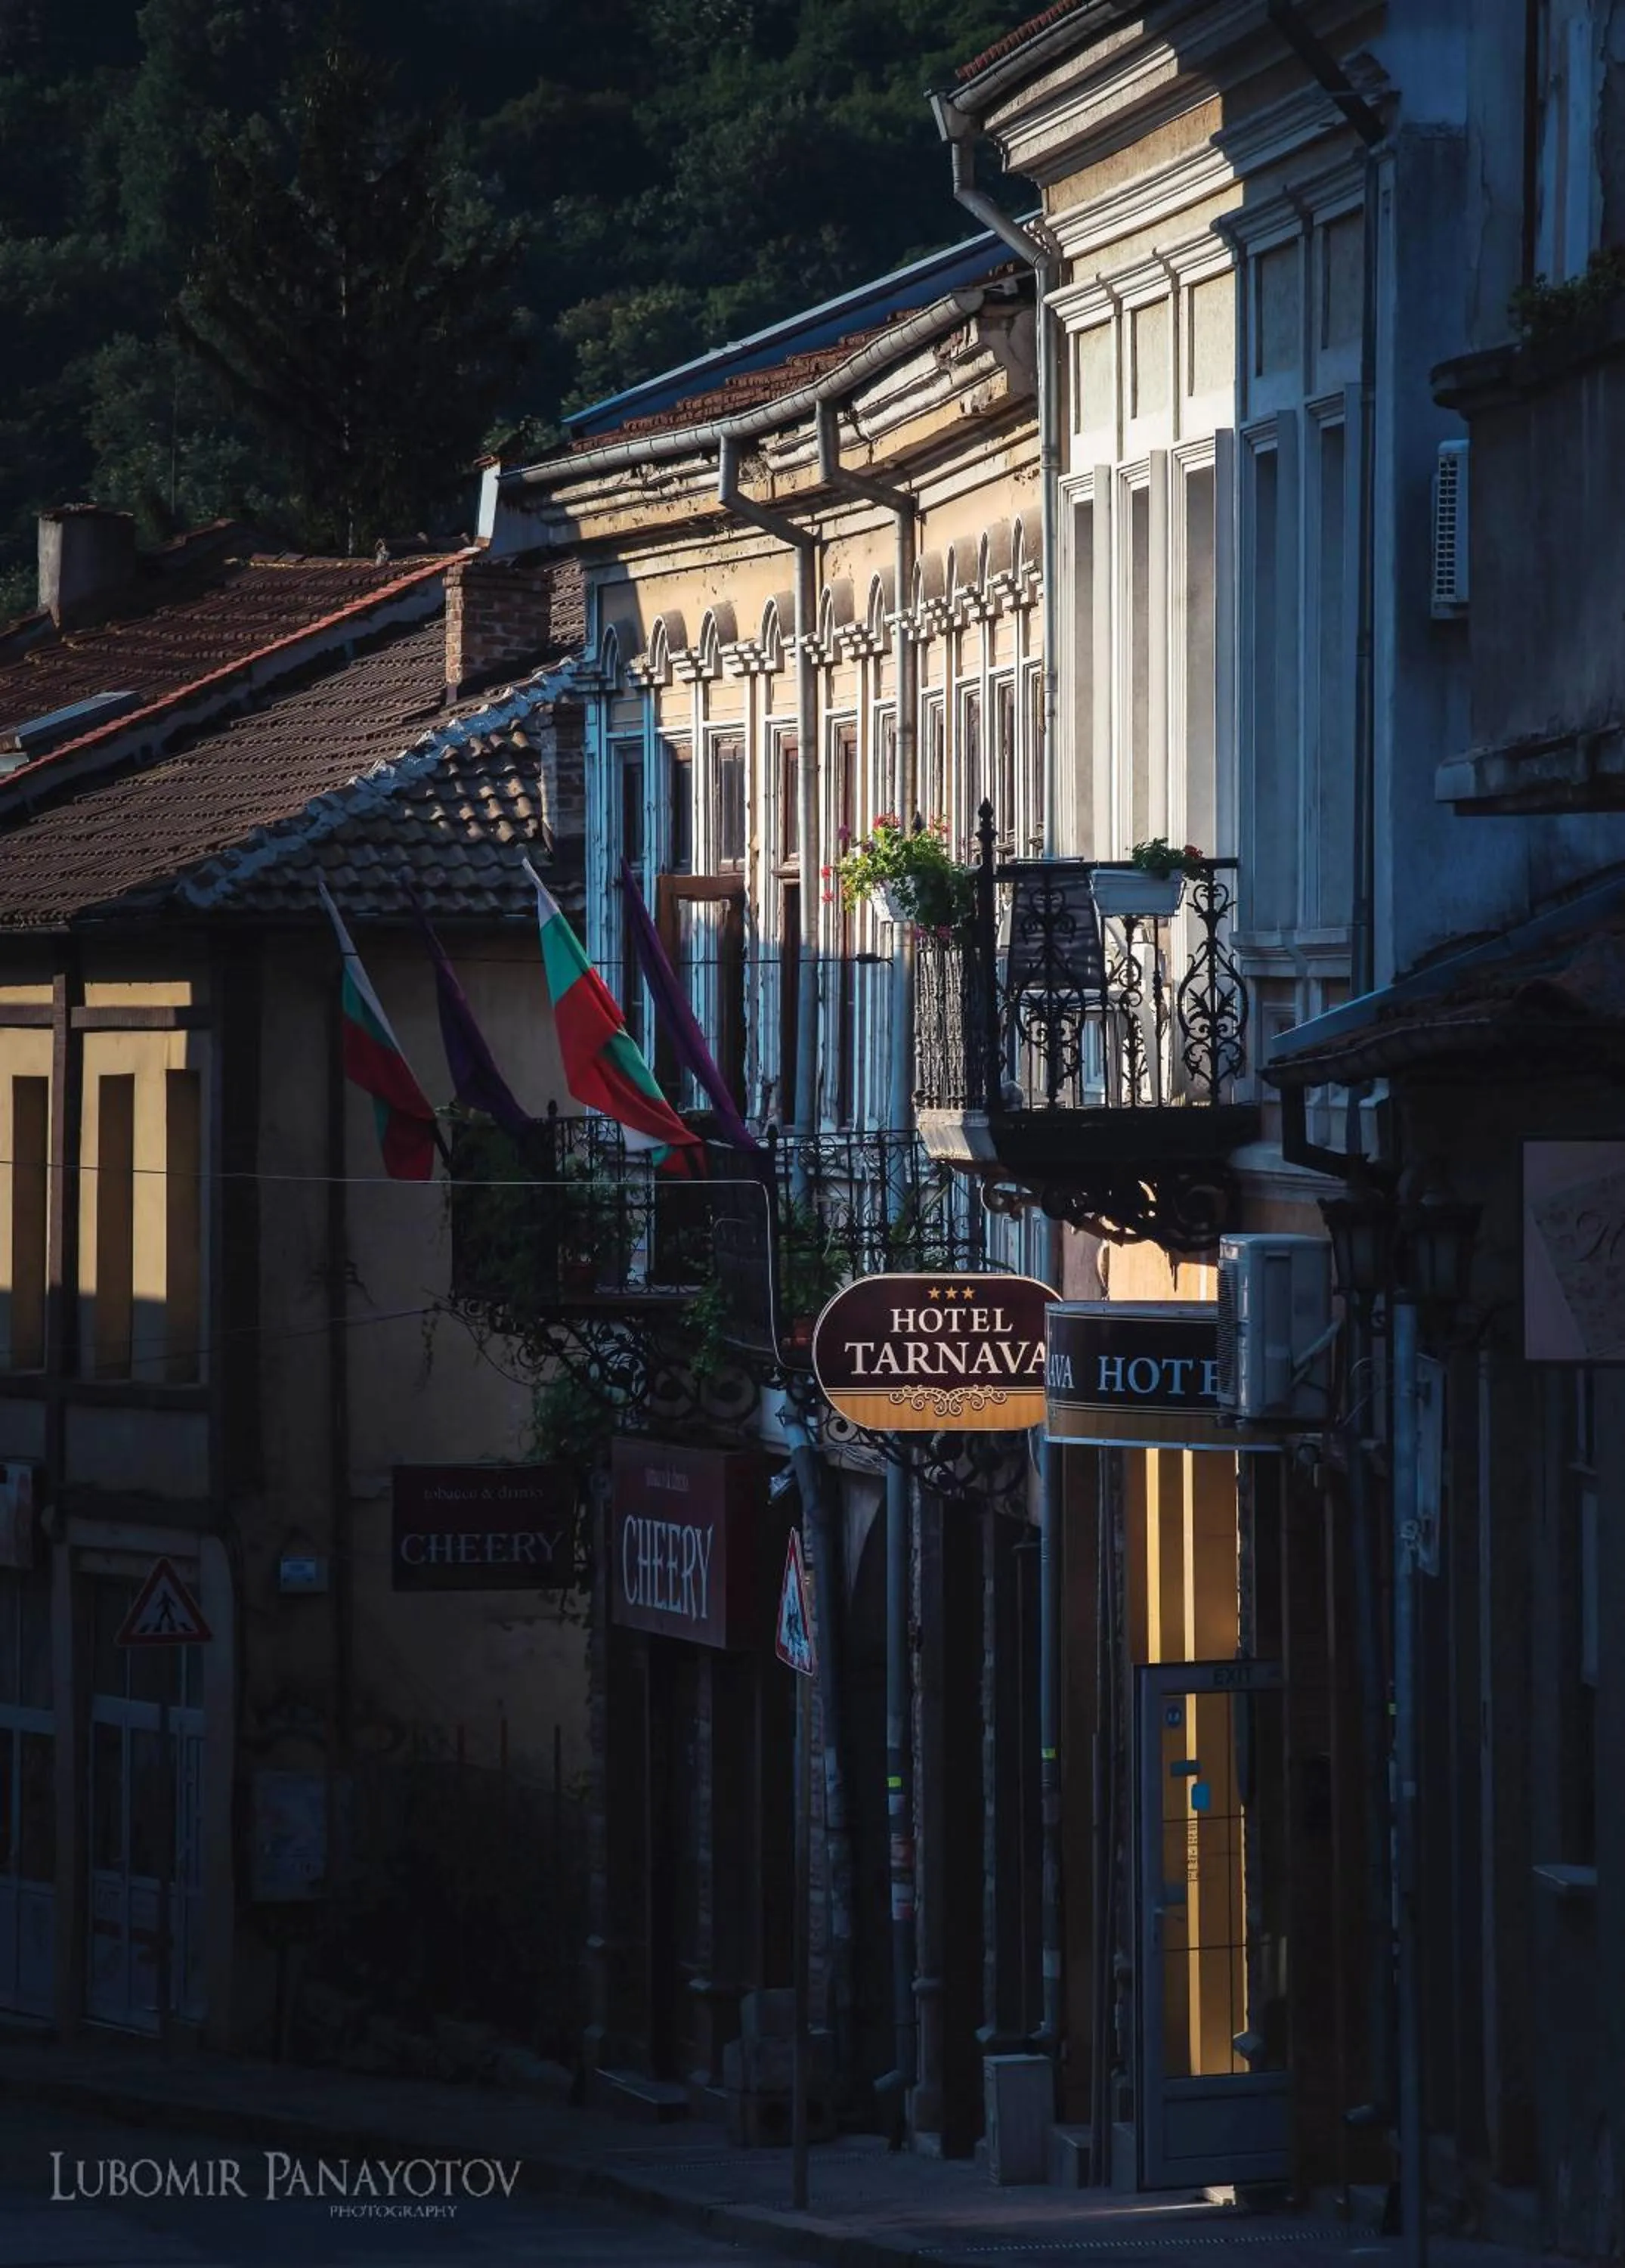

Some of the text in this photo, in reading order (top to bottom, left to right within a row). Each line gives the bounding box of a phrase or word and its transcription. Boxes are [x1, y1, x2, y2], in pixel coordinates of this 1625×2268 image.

[890, 1307, 1014, 1334] HOTEL
[843, 1340, 1045, 1376] TARNAVA
[1097, 1355, 1219, 1395] HOTE
[401, 1531, 565, 1565] CHEERY
[623, 1514, 714, 1621] CHEERY
[1213, 1668, 1253, 1685] EXIT
